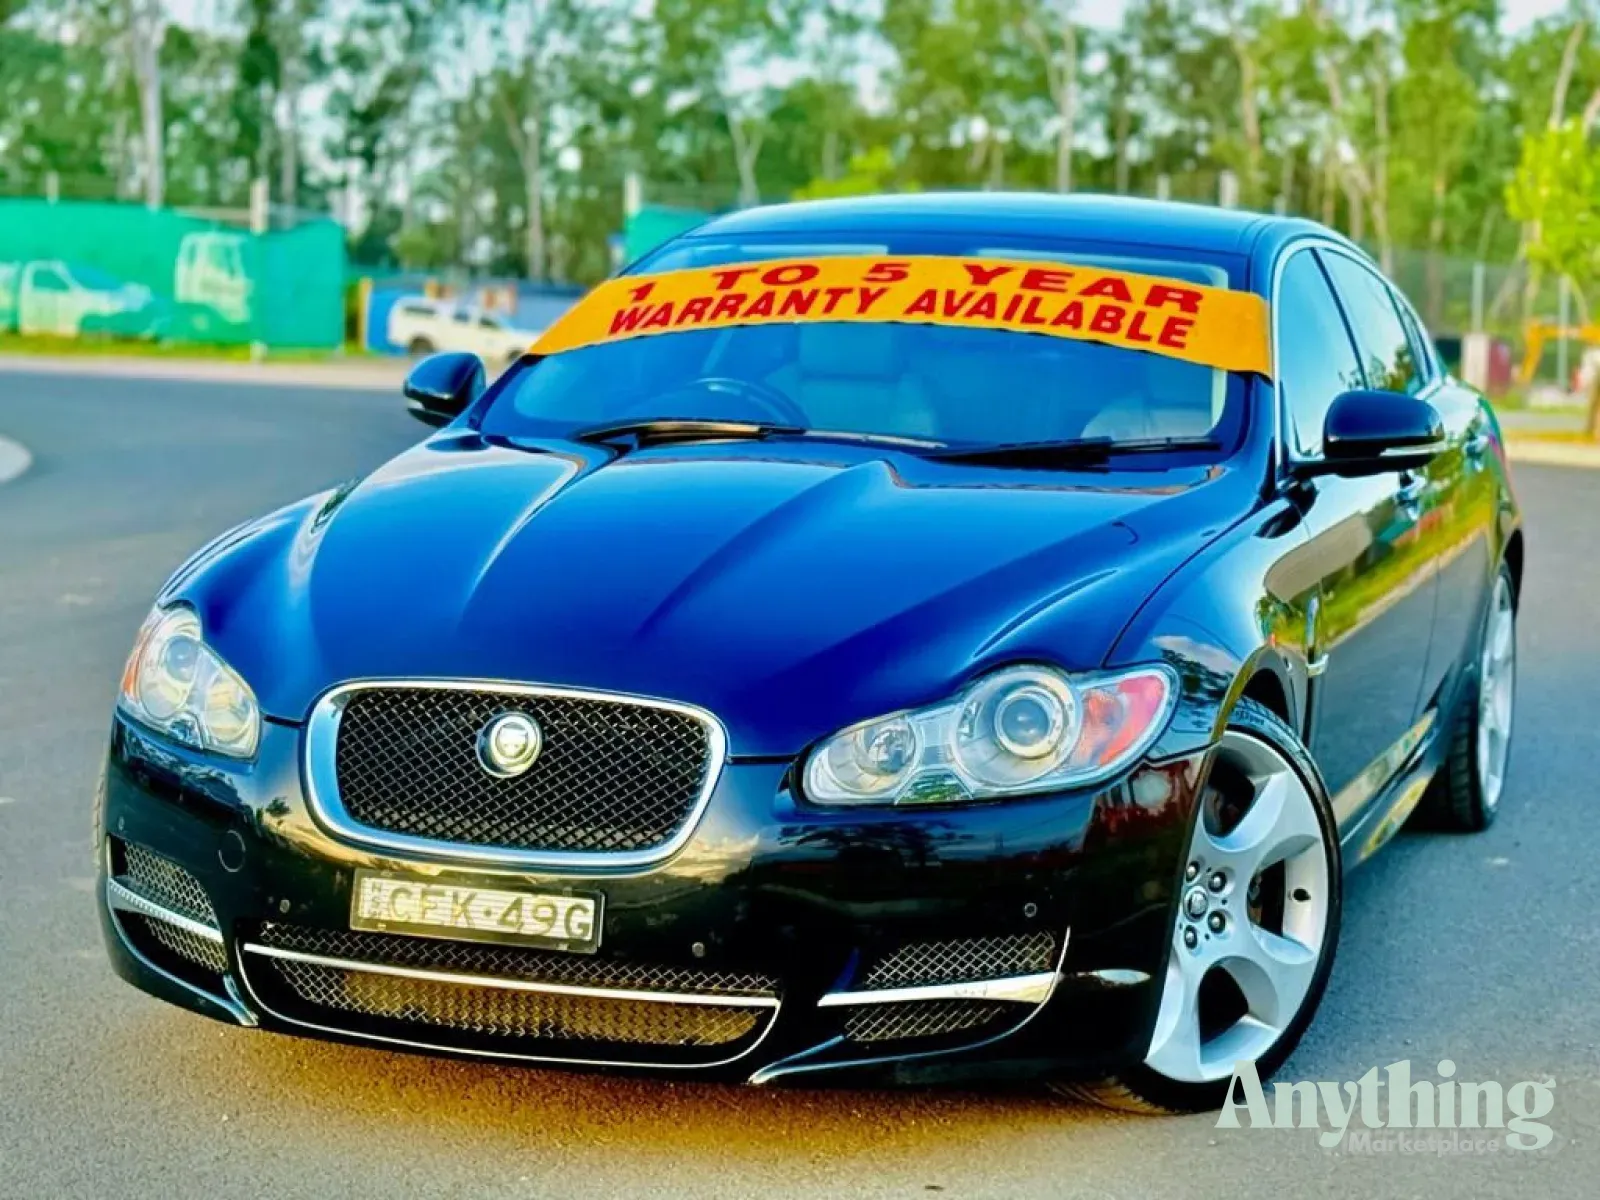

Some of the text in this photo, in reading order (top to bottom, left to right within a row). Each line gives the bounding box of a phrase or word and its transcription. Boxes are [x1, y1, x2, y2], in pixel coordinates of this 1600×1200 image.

[629, 263, 1203, 314] 1 TO 5 YEAR
[608, 287, 1194, 348] WARRANTY AVAILABLE
